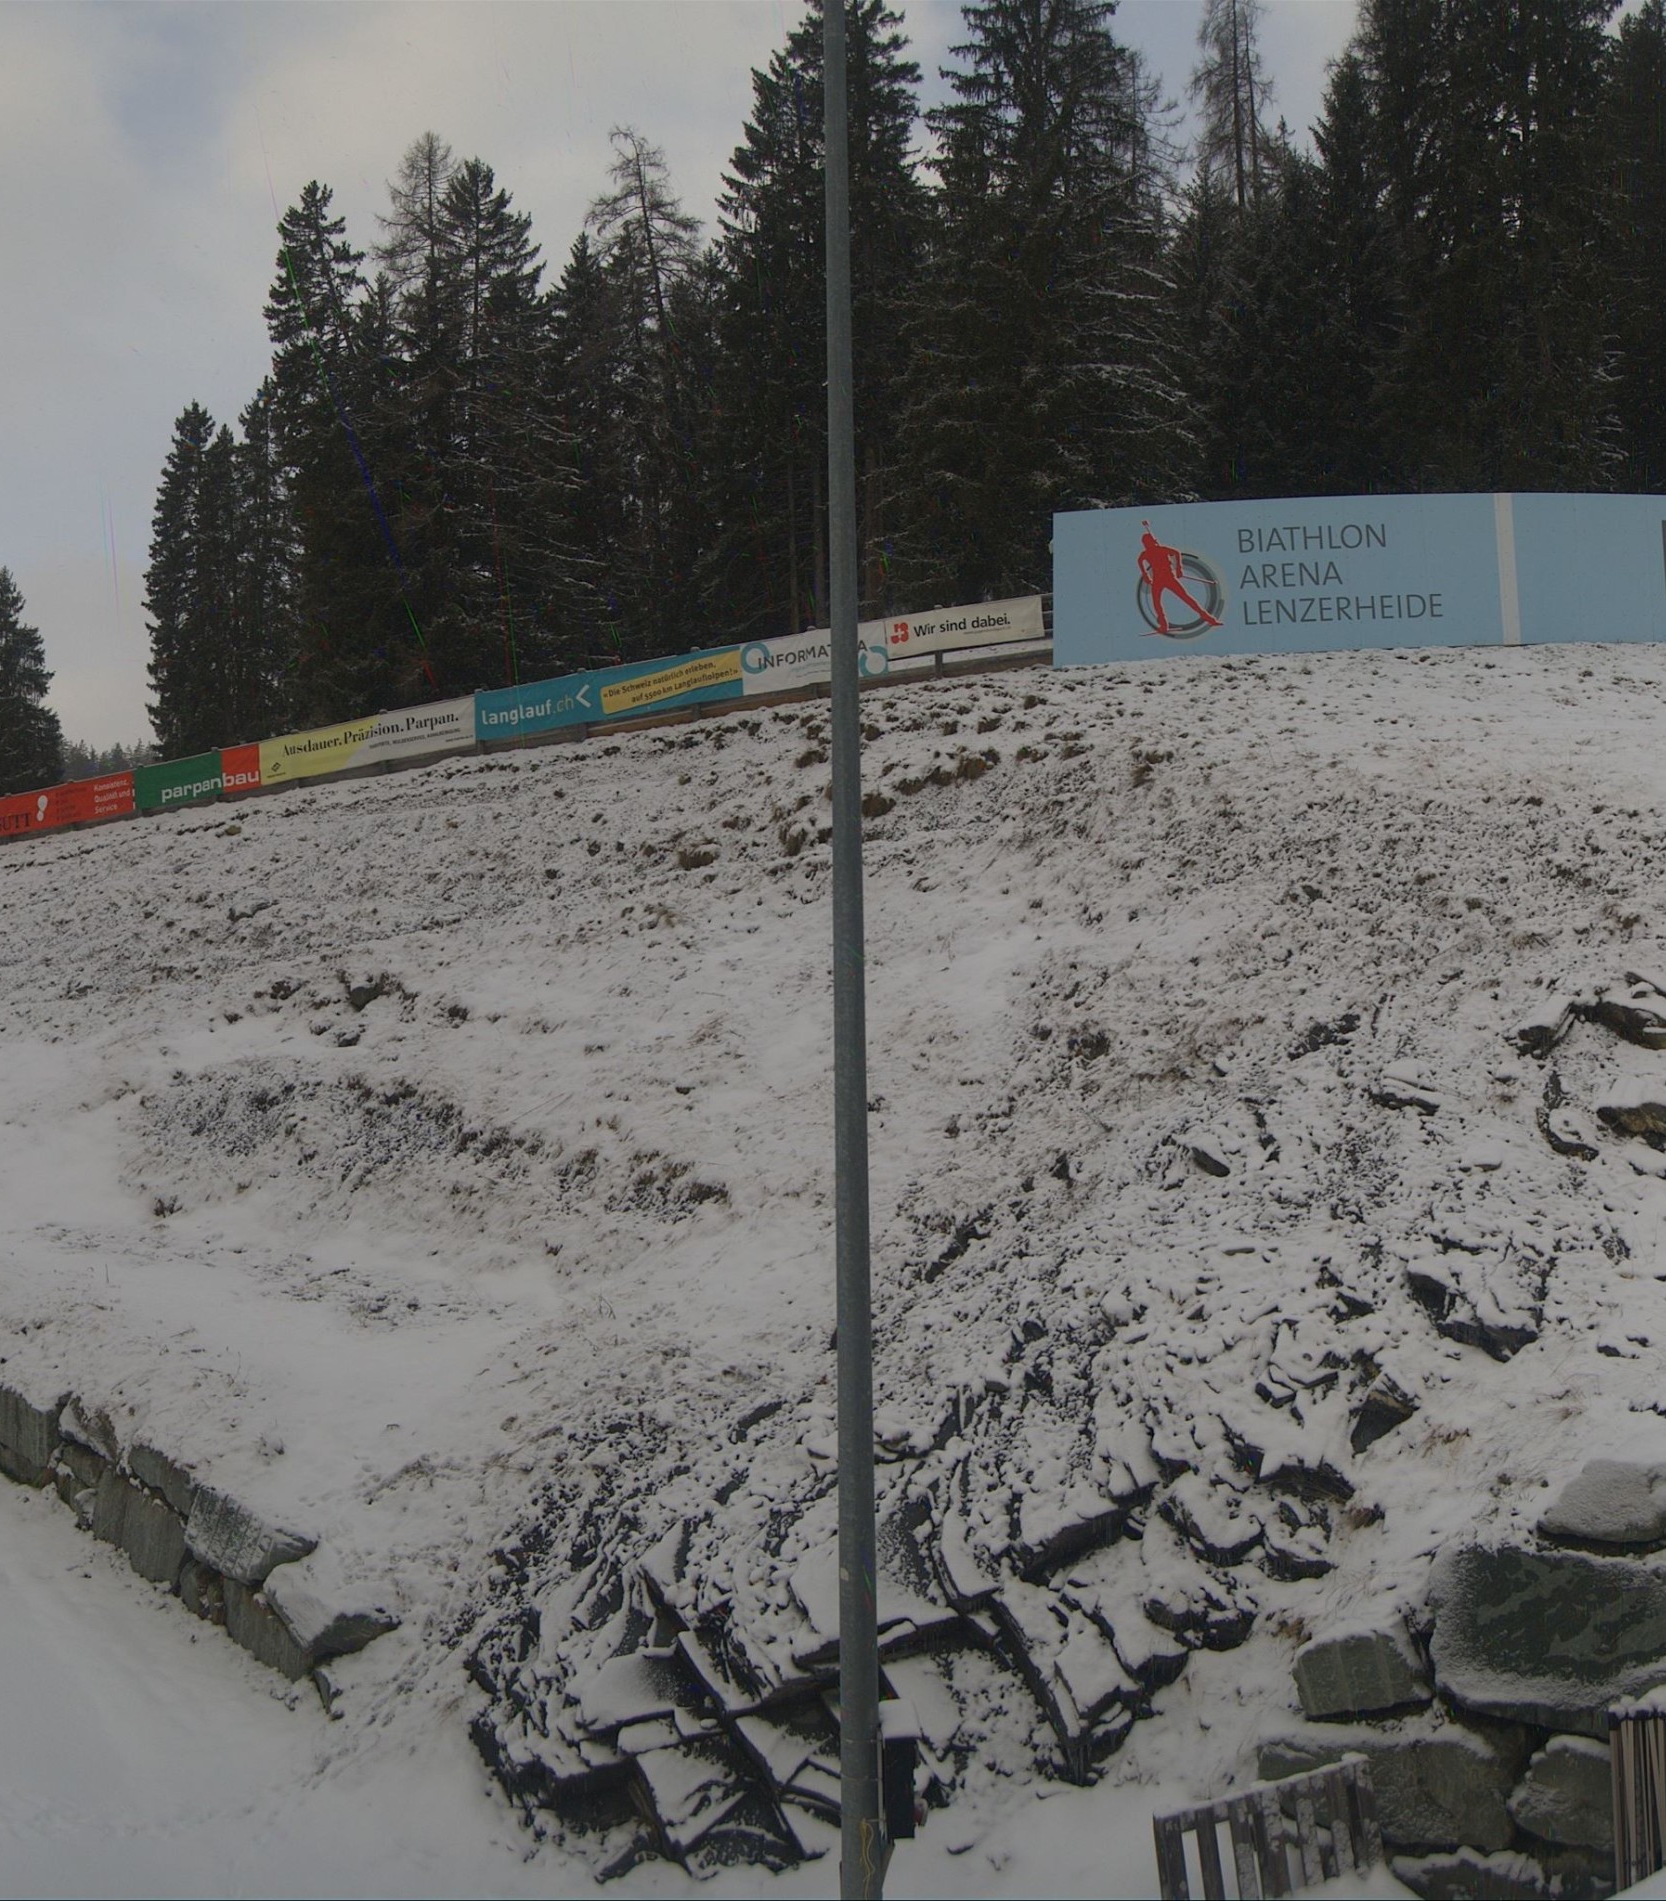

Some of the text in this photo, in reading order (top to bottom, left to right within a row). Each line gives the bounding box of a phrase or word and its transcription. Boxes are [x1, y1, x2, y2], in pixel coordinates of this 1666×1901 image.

[1237, 523, 1387, 553] BIATHLON
[1239, 561, 1343, 589] ARENA
[913, 624, 934, 637] Wir
[939, 618, 967, 632] sind
[971, 612, 1011, 629] dabei.
[1243, 593, 1444, 626] LENZERHEIDE
[481, 694, 574, 725] langlauf.ch
[343, 722, 404, 745] Präzision.
[406, 712, 459, 732] Parpan.
[118, 788, 131, 798] und
[161, 770, 259, 803] parpanbau
[94, 803, 118, 815] Service
